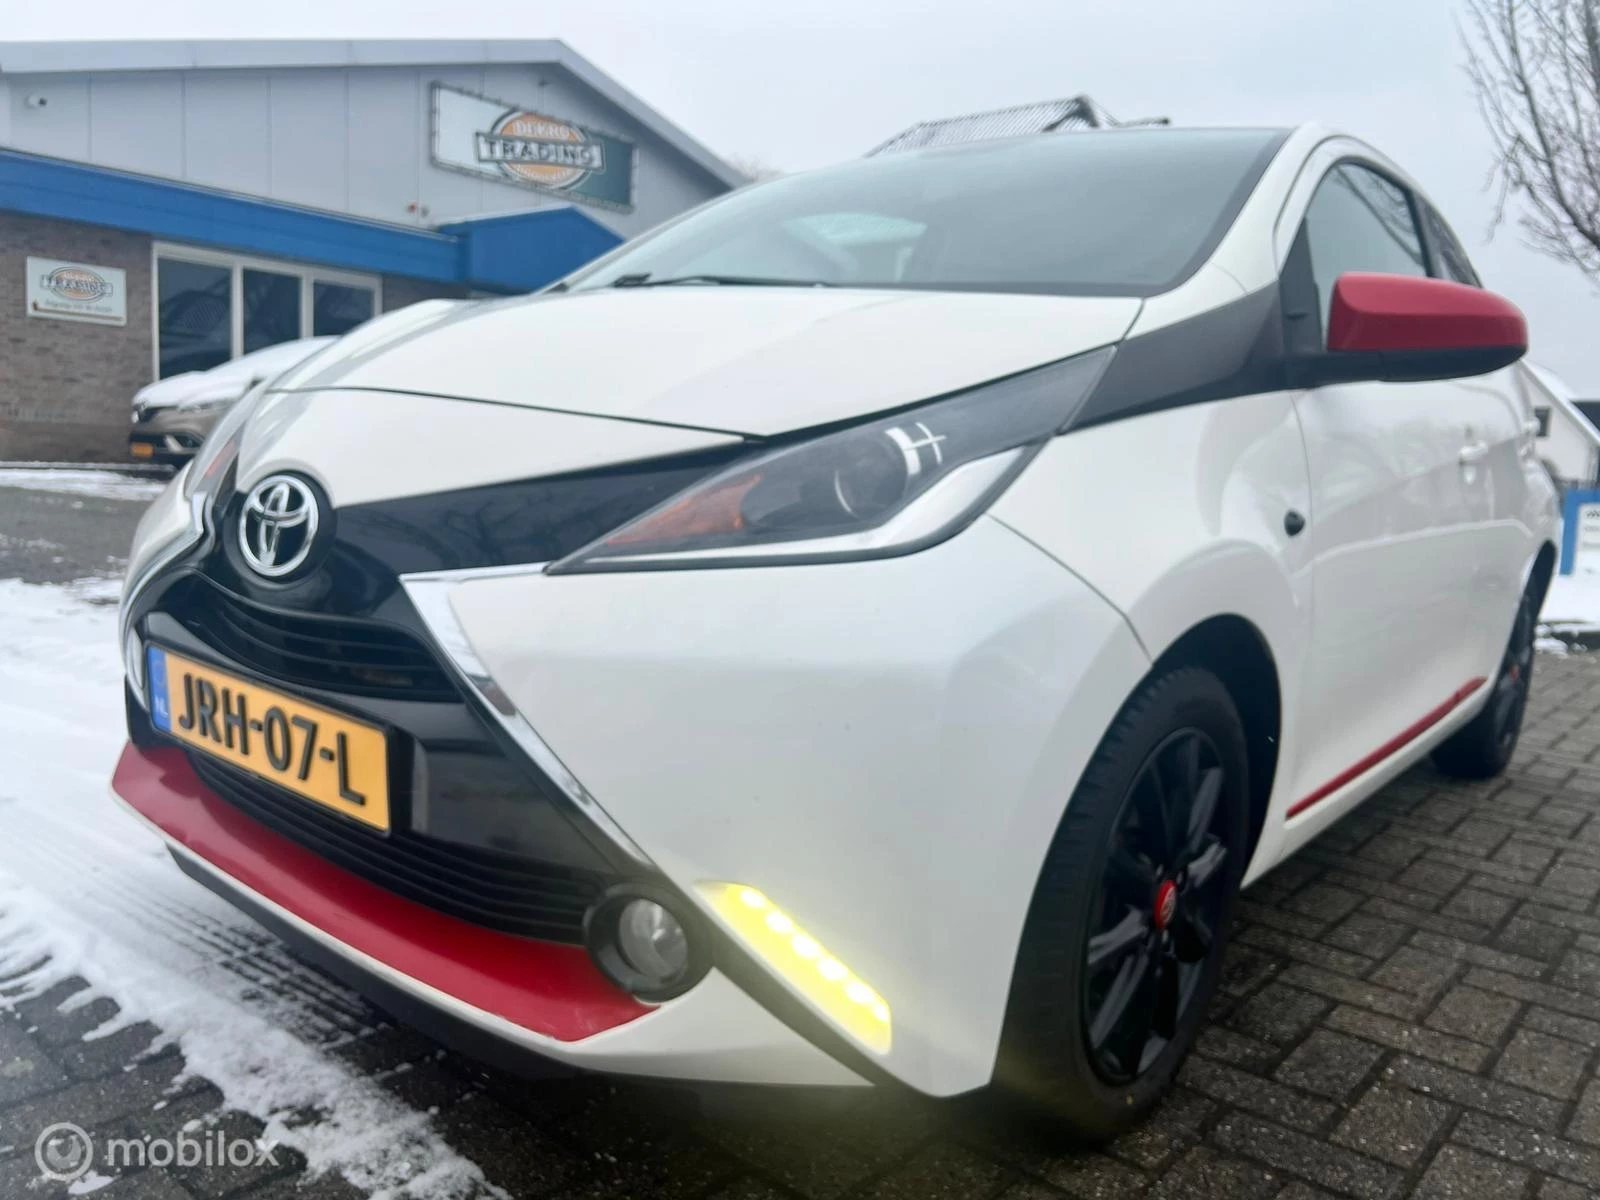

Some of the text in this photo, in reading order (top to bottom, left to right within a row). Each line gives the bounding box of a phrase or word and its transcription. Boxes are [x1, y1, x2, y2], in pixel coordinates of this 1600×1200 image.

[485, 138, 593, 165] TRADING
[155, 696, 168, 719] NL
[178, 672, 367, 806] JRH-07-L
